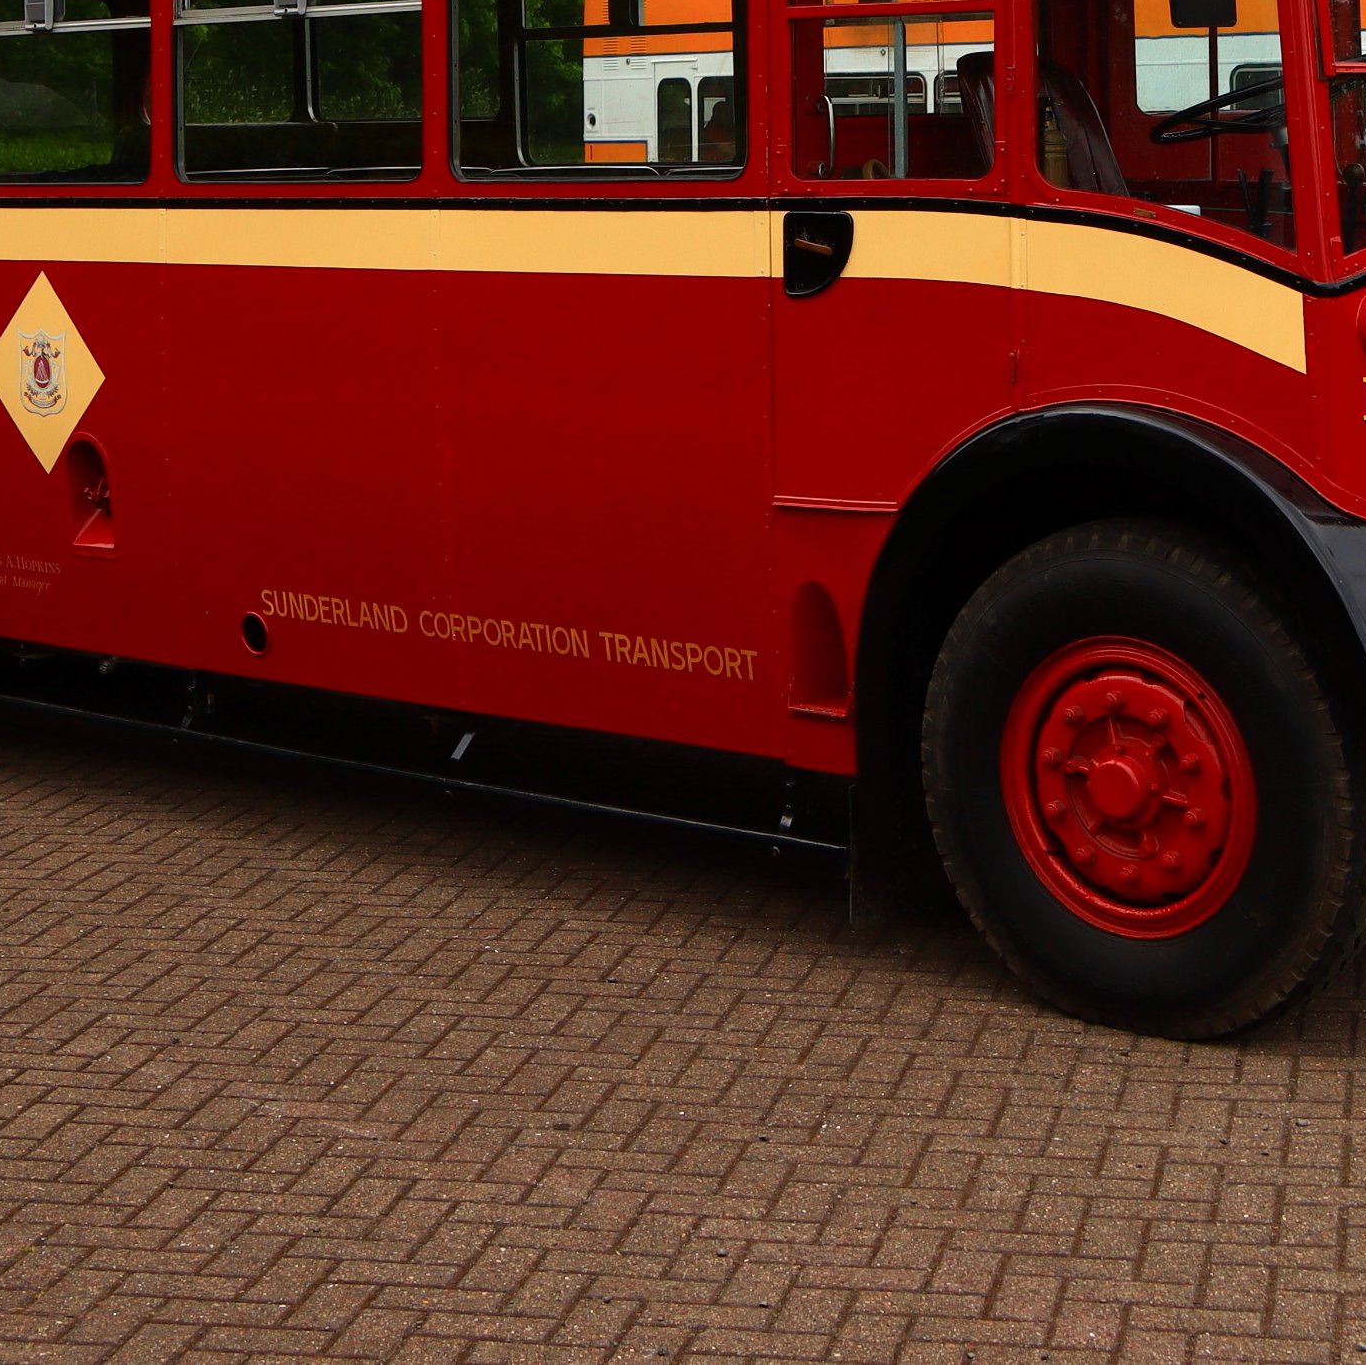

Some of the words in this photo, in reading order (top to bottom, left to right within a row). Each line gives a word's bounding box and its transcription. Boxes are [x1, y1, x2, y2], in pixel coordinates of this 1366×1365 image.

[260, 588, 409, 634] SUNDERLAND
[419, 609, 590, 659] CORPORATION
[598, 631, 758, 681] TRANSPORT
